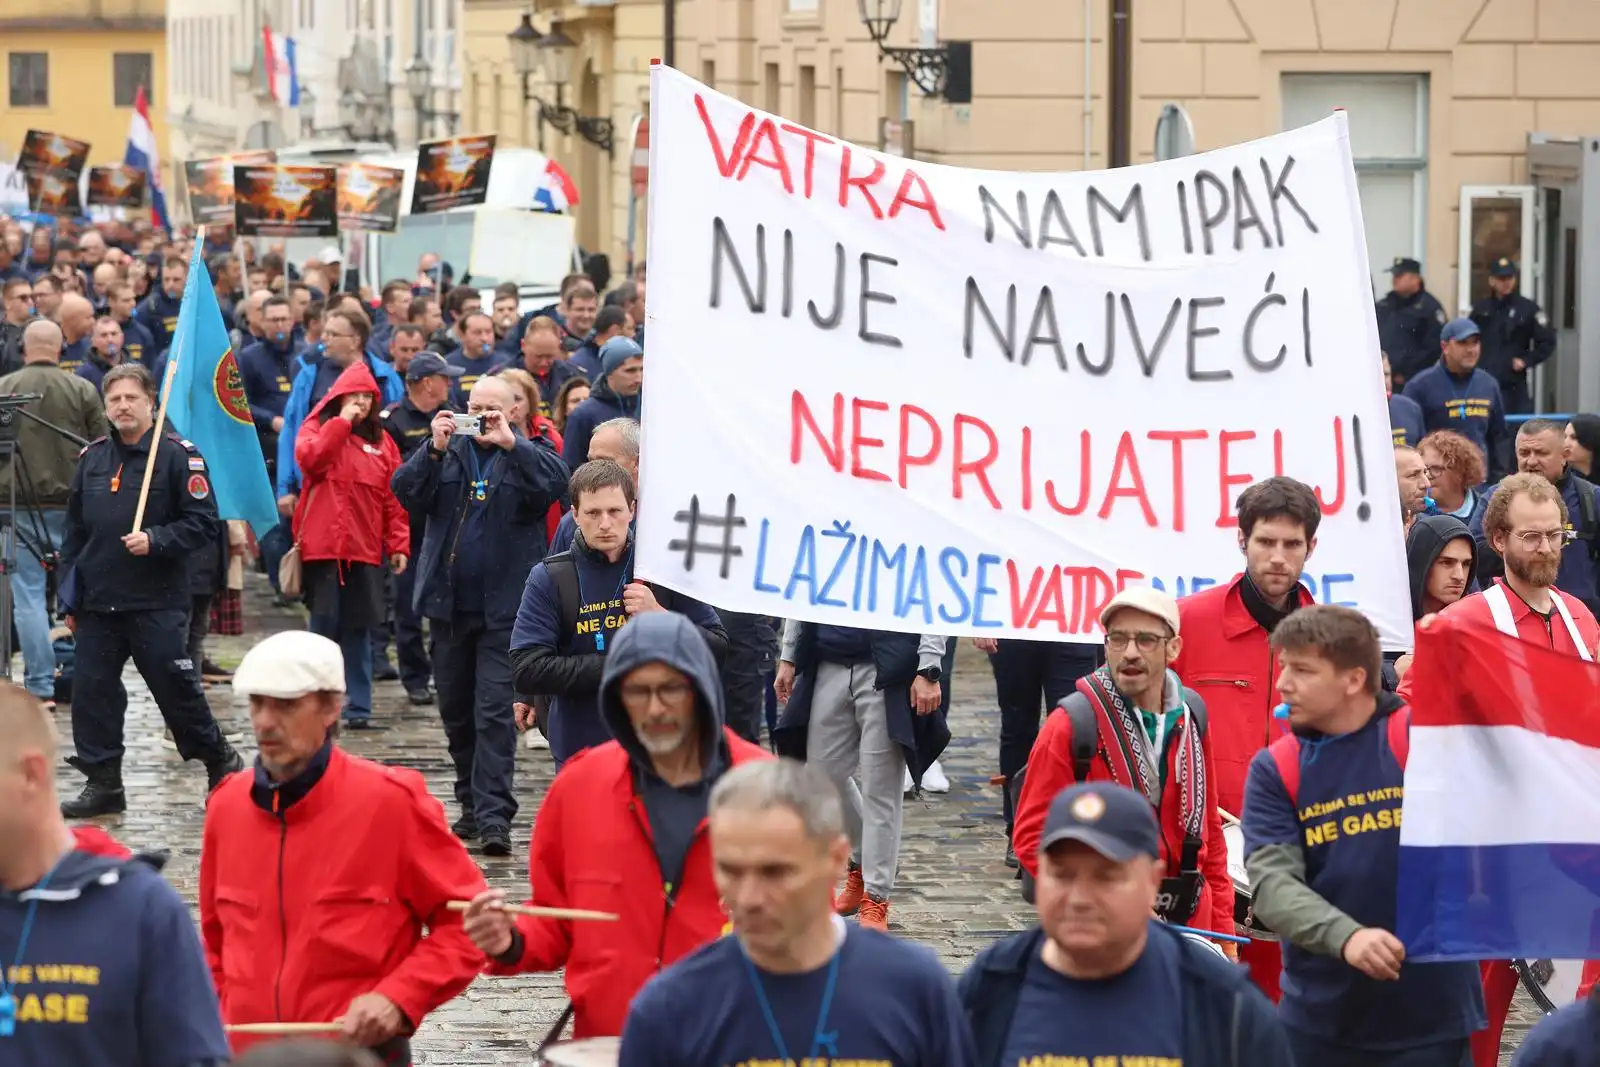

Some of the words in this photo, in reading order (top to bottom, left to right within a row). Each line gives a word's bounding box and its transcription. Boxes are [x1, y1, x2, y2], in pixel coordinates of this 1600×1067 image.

[695, 94, 946, 232] VATRA
[978, 184, 1151, 262] NAM
[1177, 154, 1319, 256] IPAK
[711, 216, 903, 348] NIJE
[963, 271, 1313, 382] NAJVEĆI
[579, 602, 607, 614] AŽIMA
[608, 599, 621, 608] SE
[576, 618, 601, 635] NE
[1347, 793, 1367, 806] SE
[1367, 786, 1404, 802] VATR
[1305, 821, 1339, 847] NE
[1342, 808, 1402, 836] GASE
[15, 992, 89, 1024] ASE
